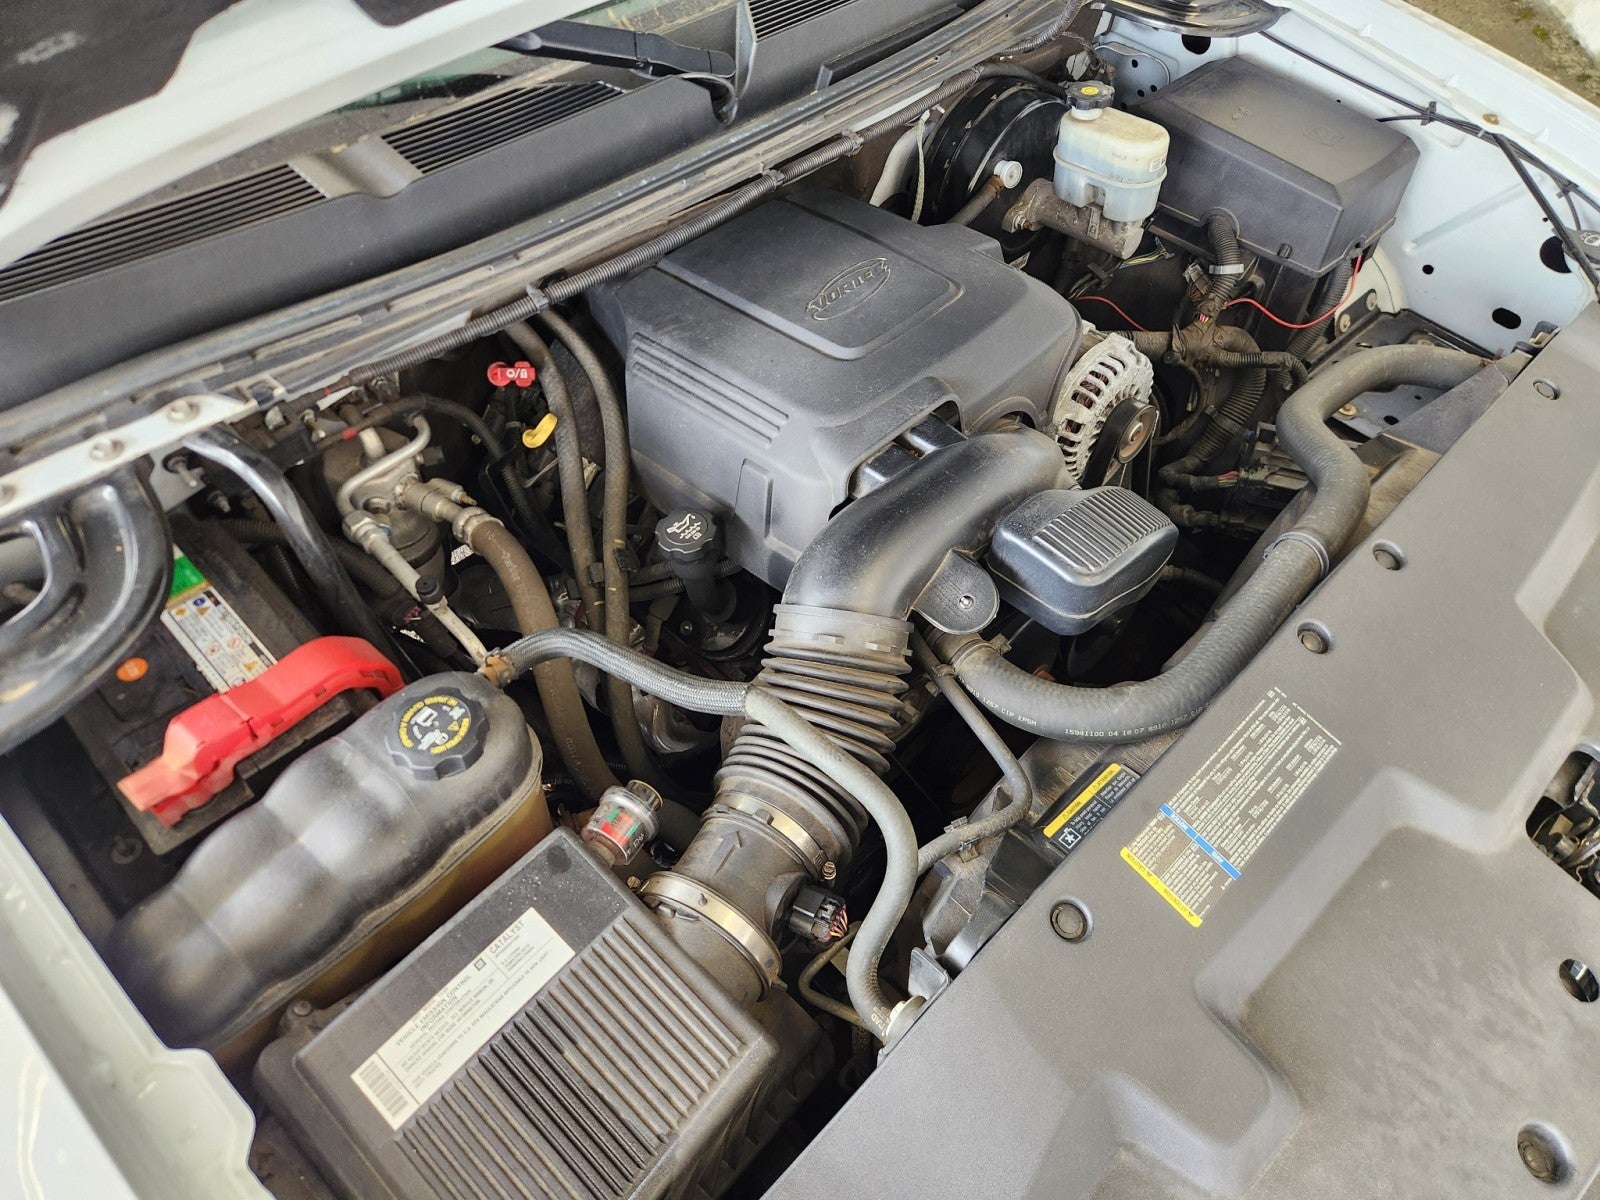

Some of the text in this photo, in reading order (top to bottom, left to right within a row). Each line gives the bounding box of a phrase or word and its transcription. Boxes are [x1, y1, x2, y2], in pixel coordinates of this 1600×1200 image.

[1065, 728, 1104, 737] 15941100
[489, 920, 525, 954] CATALYST
[419, 997, 445, 1023] EMISSION
